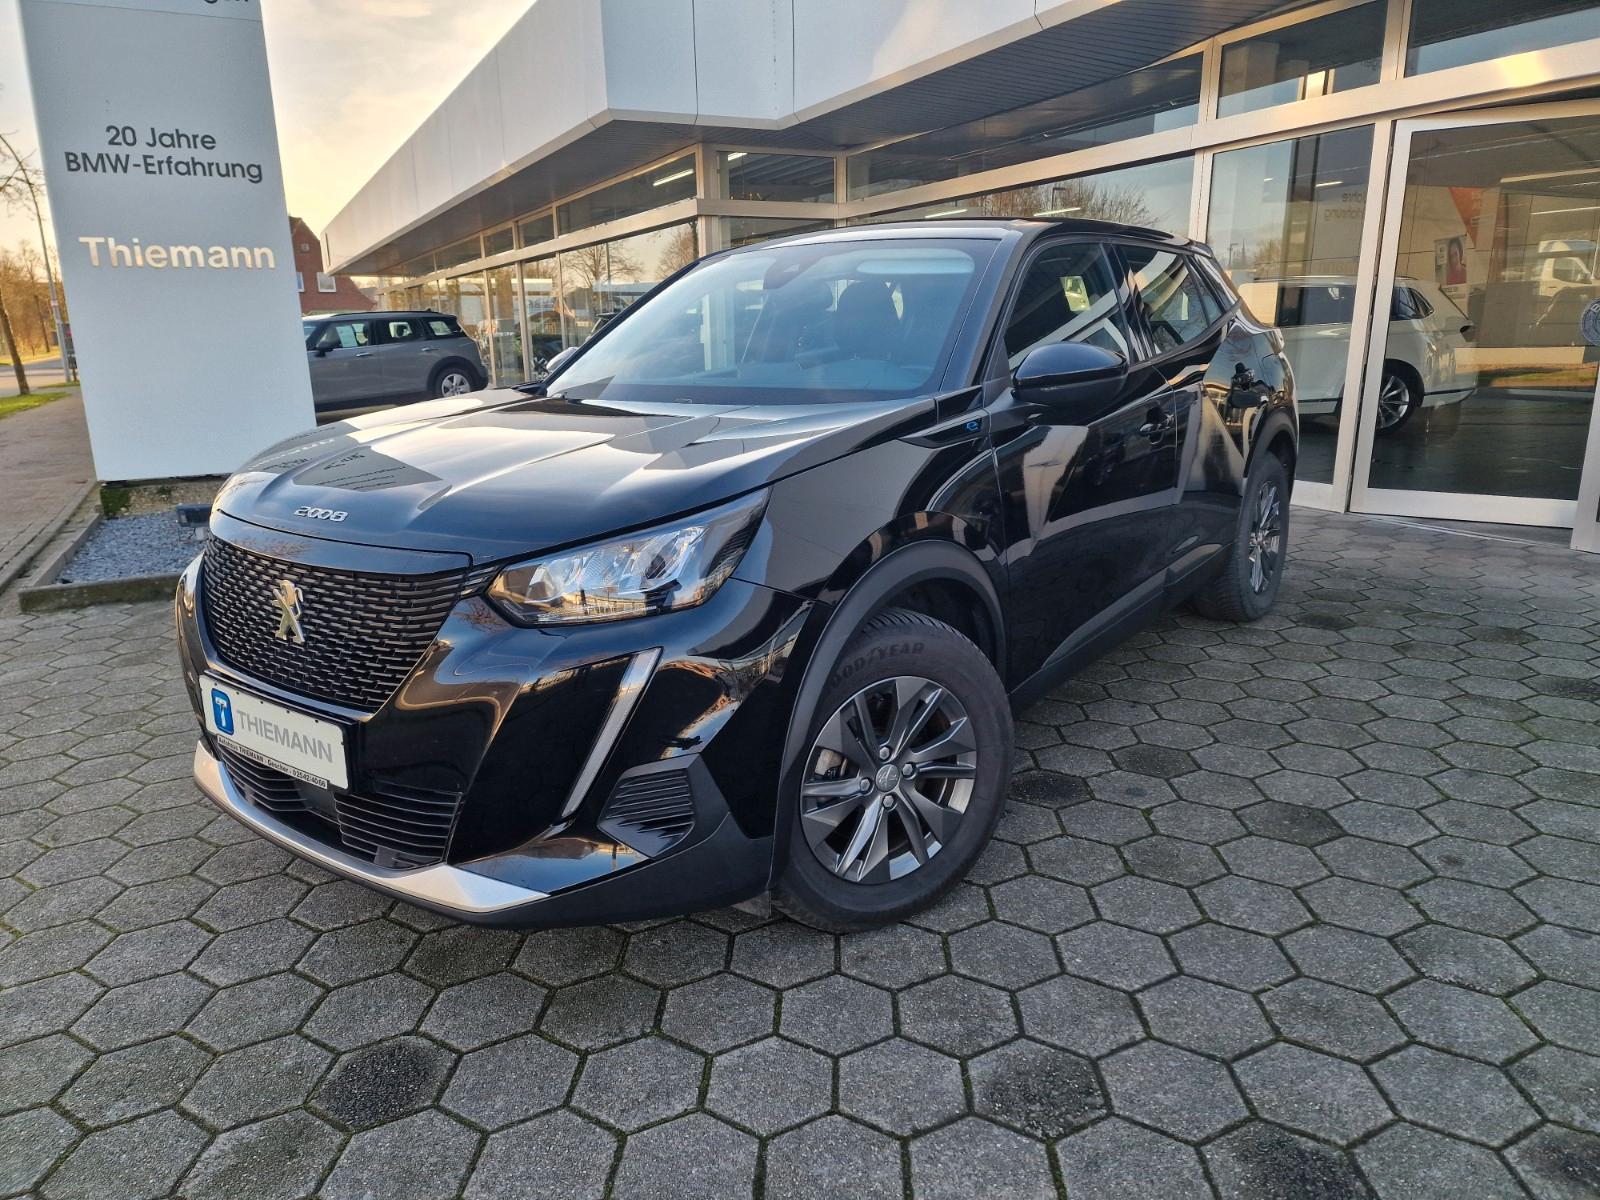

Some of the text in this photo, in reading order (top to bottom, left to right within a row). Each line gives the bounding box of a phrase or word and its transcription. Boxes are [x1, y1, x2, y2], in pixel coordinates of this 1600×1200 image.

[105, 124, 217, 150] 20 Jahre
[64, 151, 263, 184] BMW-Erfahrung
[78, 236, 276, 269] Thiemann
[293, 505, 349, 522] 2008
[236, 710, 333, 763] THIEMANN
